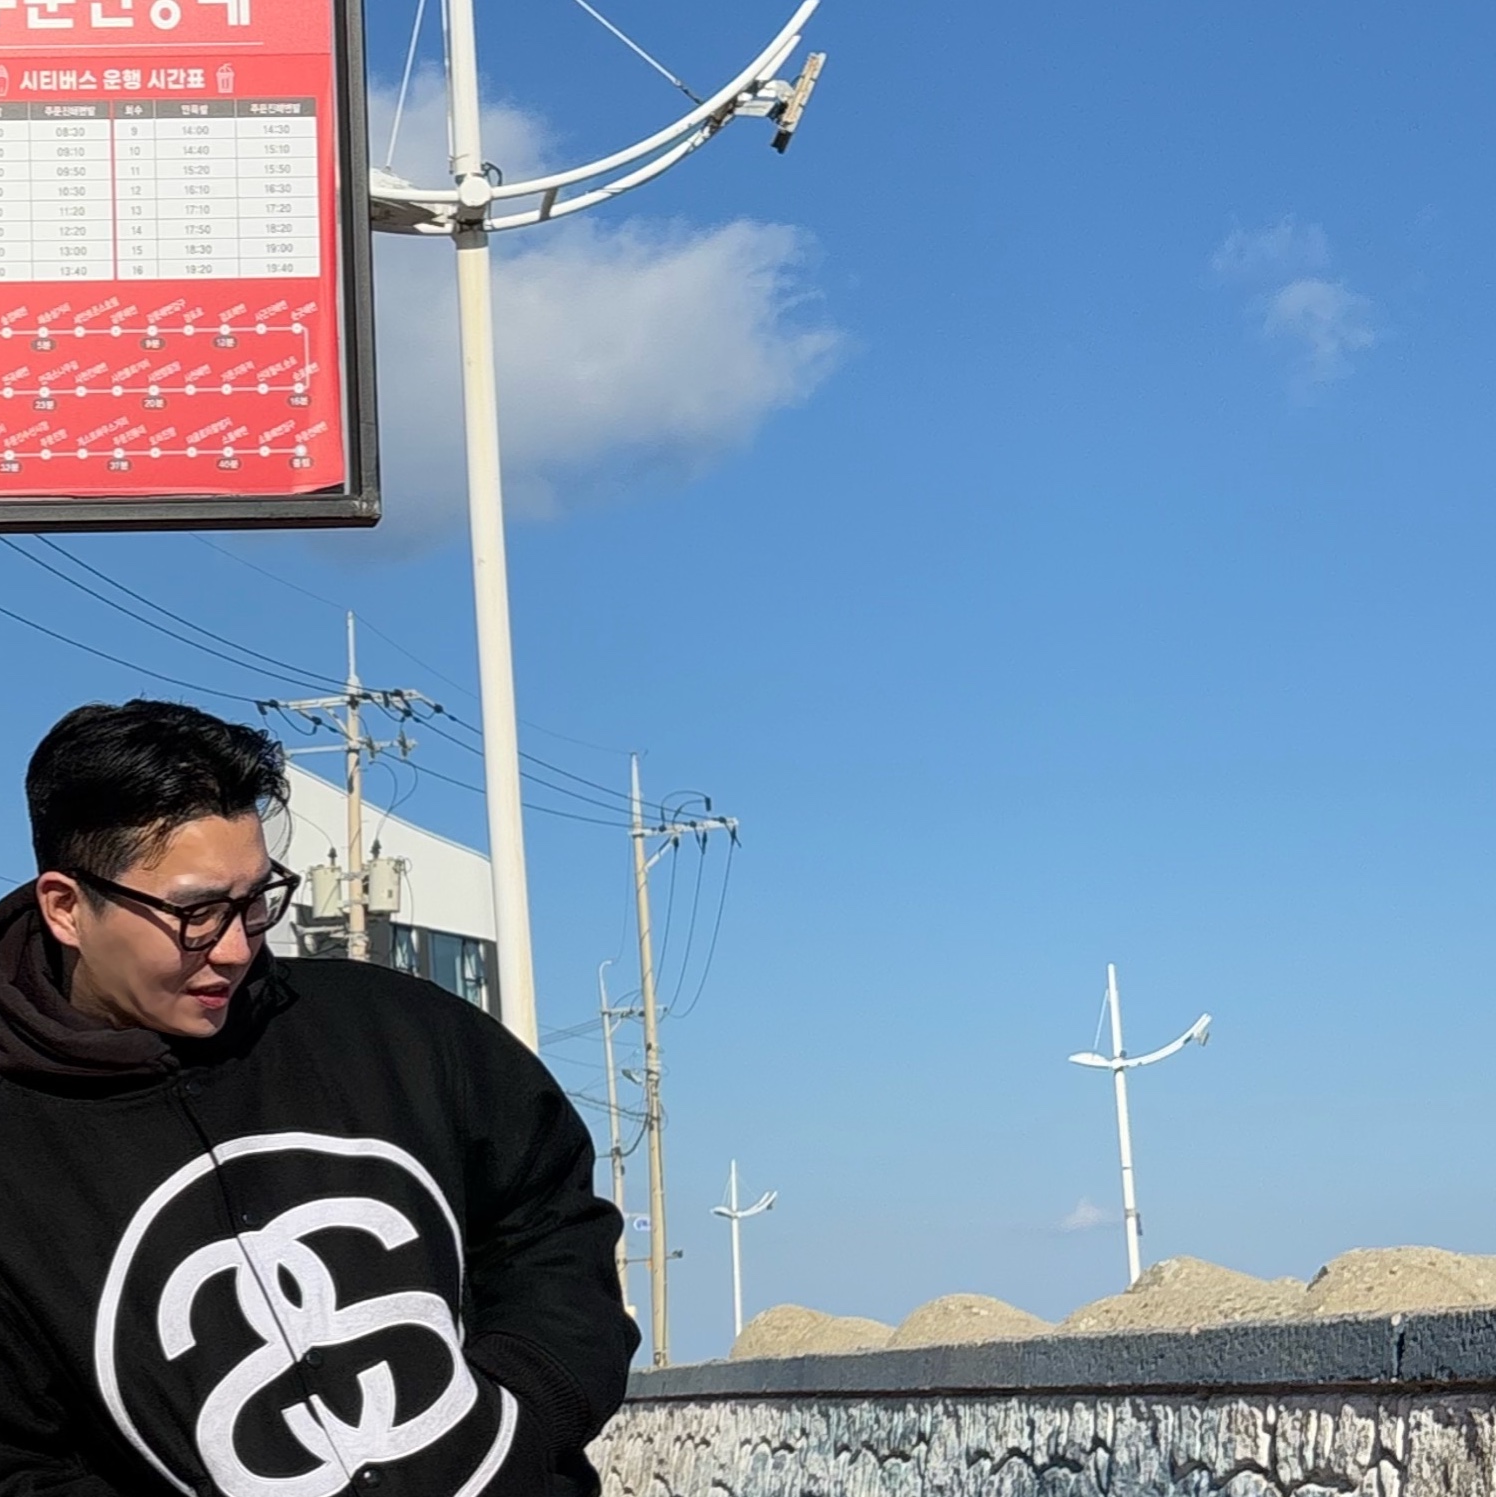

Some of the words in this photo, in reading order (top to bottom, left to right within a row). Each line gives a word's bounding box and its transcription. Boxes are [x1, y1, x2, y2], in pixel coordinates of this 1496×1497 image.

[18, 70, 97, 91] 시티버스
[103, 69, 141, 90] 운행
[147, 67, 206, 90] 시간표
[182, 125, 210, 136] 14:00
[263, 124, 291, 135] 14:30
[56, 146, 85, 158] 09:10
[129, 145, 141, 156] 10
[183, 145, 210, 156] 14:40
[264, 143, 291, 155] 15:10
[130, 166, 140, 176] 11
[183, 164, 211, 176] 15:20
[58, 186, 86, 197] 10:30
[130, 185, 142, 196] 12
[59, 205, 86, 217] 11:20
[130, 205, 143, 216] 13
[185, 204, 211, 215] 17:10
[265, 203, 292, 213] 17:20
[59, 226, 87, 237] 12:20
[131, 225, 143, 235] 14
[184, 224, 212, 235] 17:50
[265, 223, 293, 234] 18:20
[59, 246, 88, 257] 13:00
[131, 245, 143, 256] 15
[185, 244, 213, 255] 18:30
[266, 243, 294, 254] 19:00
[60, 266, 88, 277] 13:40
[132, 265, 144, 276] 16
[266, 263, 294, 273] 19:40
